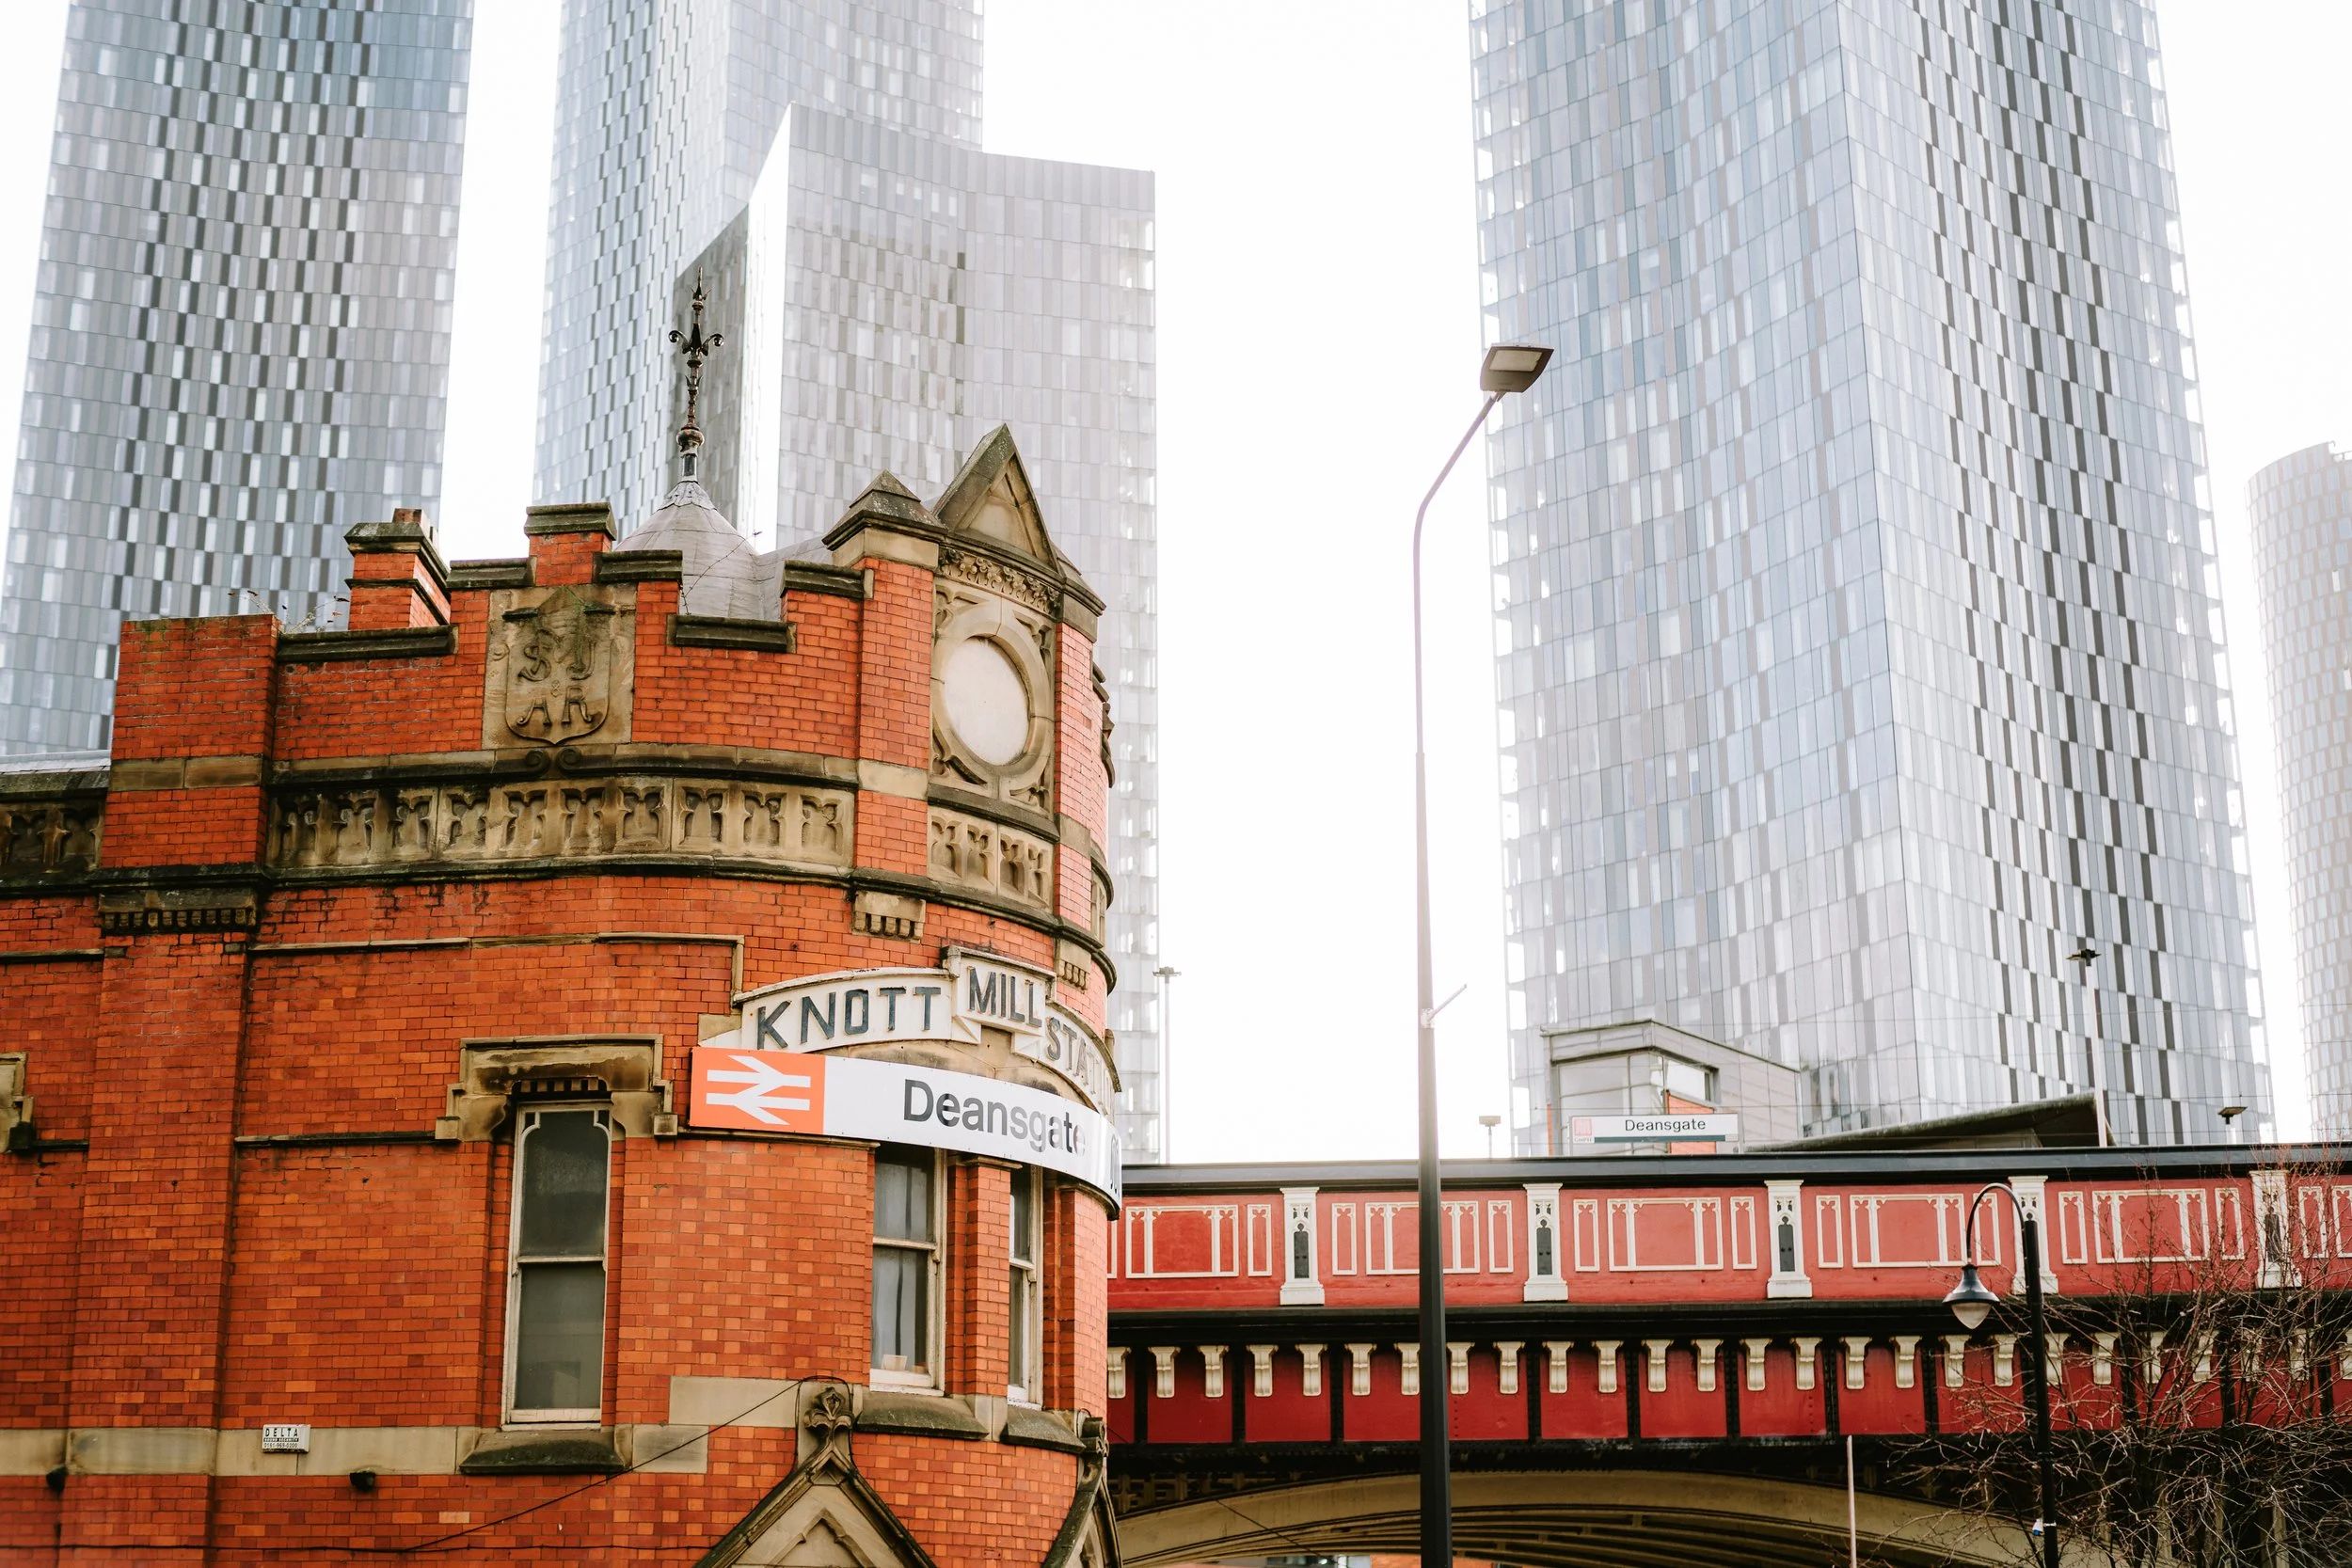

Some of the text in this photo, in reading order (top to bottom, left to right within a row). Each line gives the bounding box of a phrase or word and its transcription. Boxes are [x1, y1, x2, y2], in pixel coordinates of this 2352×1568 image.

[756, 986, 942, 1050] KNOTT
[967, 965, 1042, 1028] MILL
[904, 1079, 1087, 1157] Deansgate
[1625, 1118, 1706, 1132] Deansgate
[265, 1428, 298, 1437] DELTA
